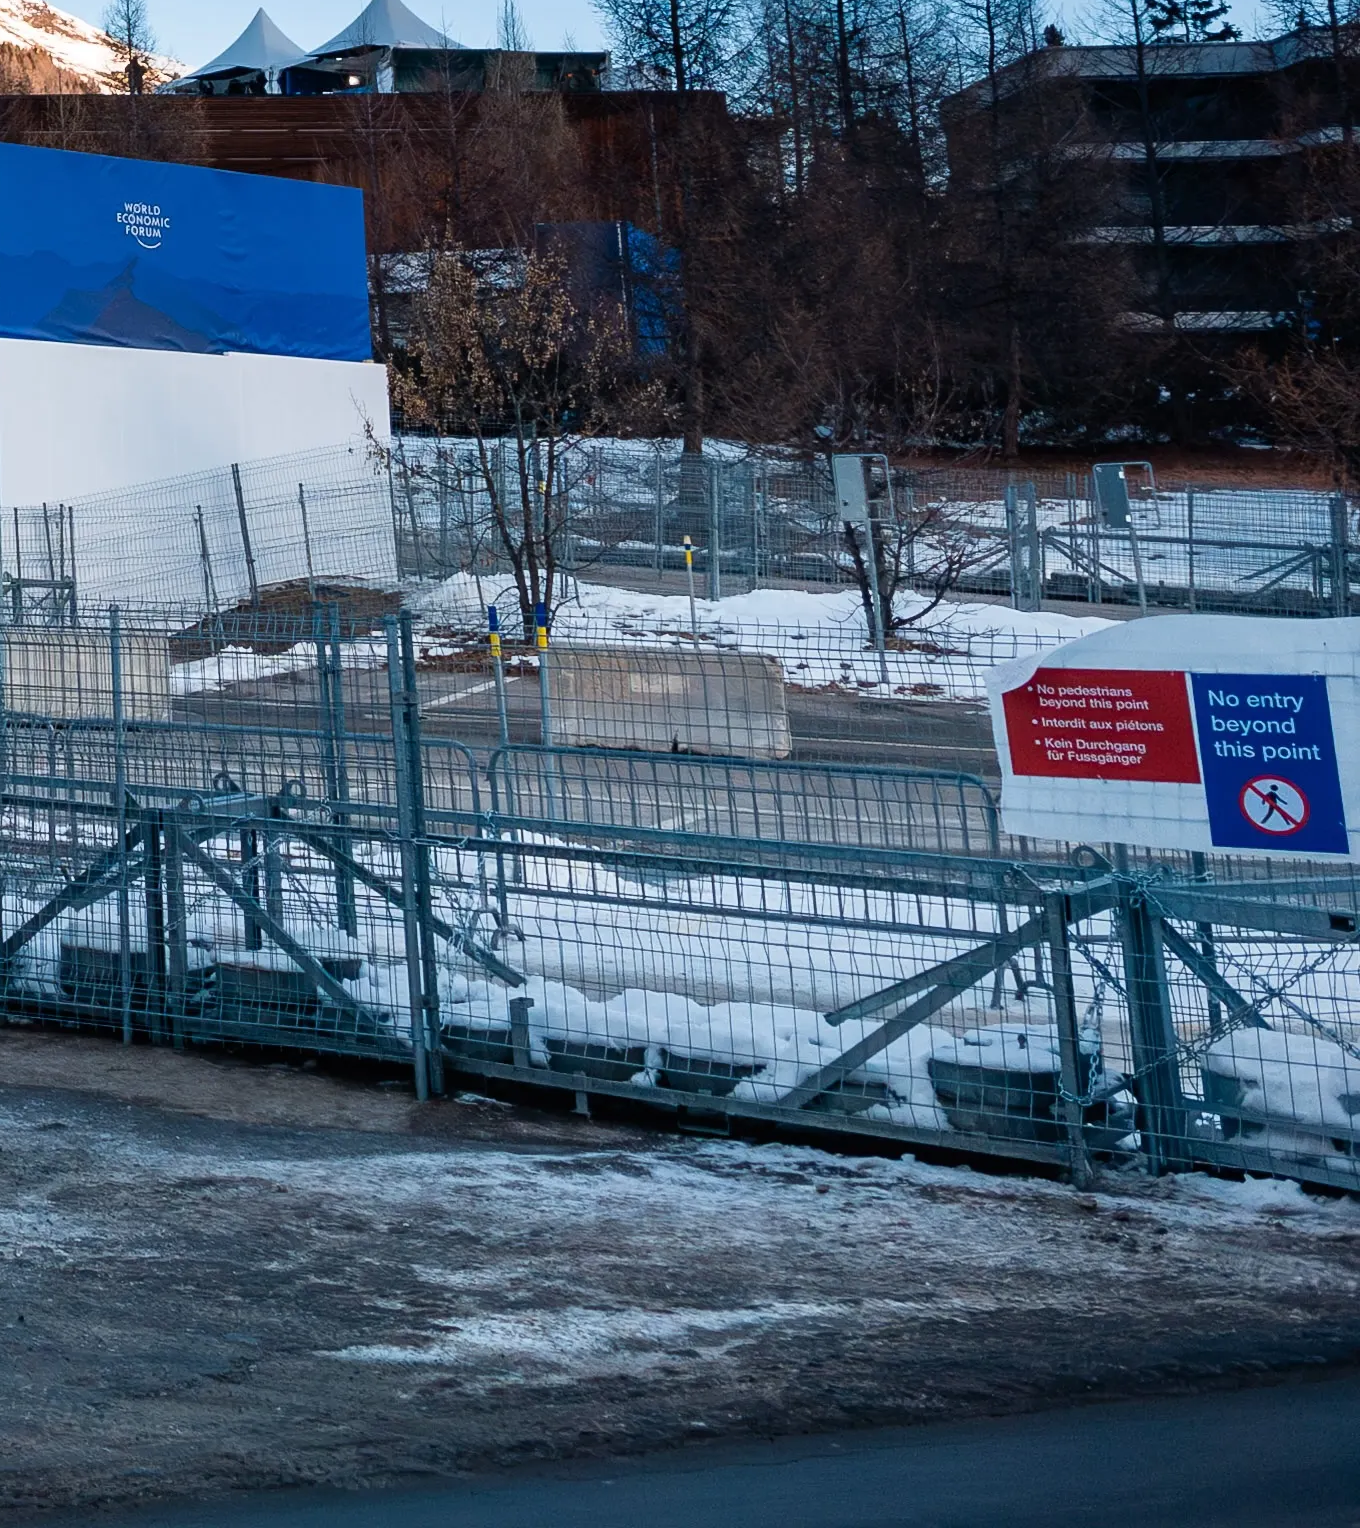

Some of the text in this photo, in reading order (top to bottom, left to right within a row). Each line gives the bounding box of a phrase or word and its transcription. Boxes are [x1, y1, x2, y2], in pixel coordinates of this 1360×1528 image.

[124, 201, 161, 216] WORLD
[116, 212, 170, 229] ECONOMIC
[125, 225, 162, 238] FORUM
[1036, 683, 1133, 697] No pedestrians
[1039, 697, 1150, 711] beyond this point
[1208, 689, 1304, 713] No entry
[1042, 717, 1164, 732] Interdit aux piétons
[1211, 715, 1296, 737] beyond
[1044, 737, 1146, 754] Kein Durchgang
[1214, 740, 1322, 762] this point
[1047, 750, 1142, 766] für Fussgänger
